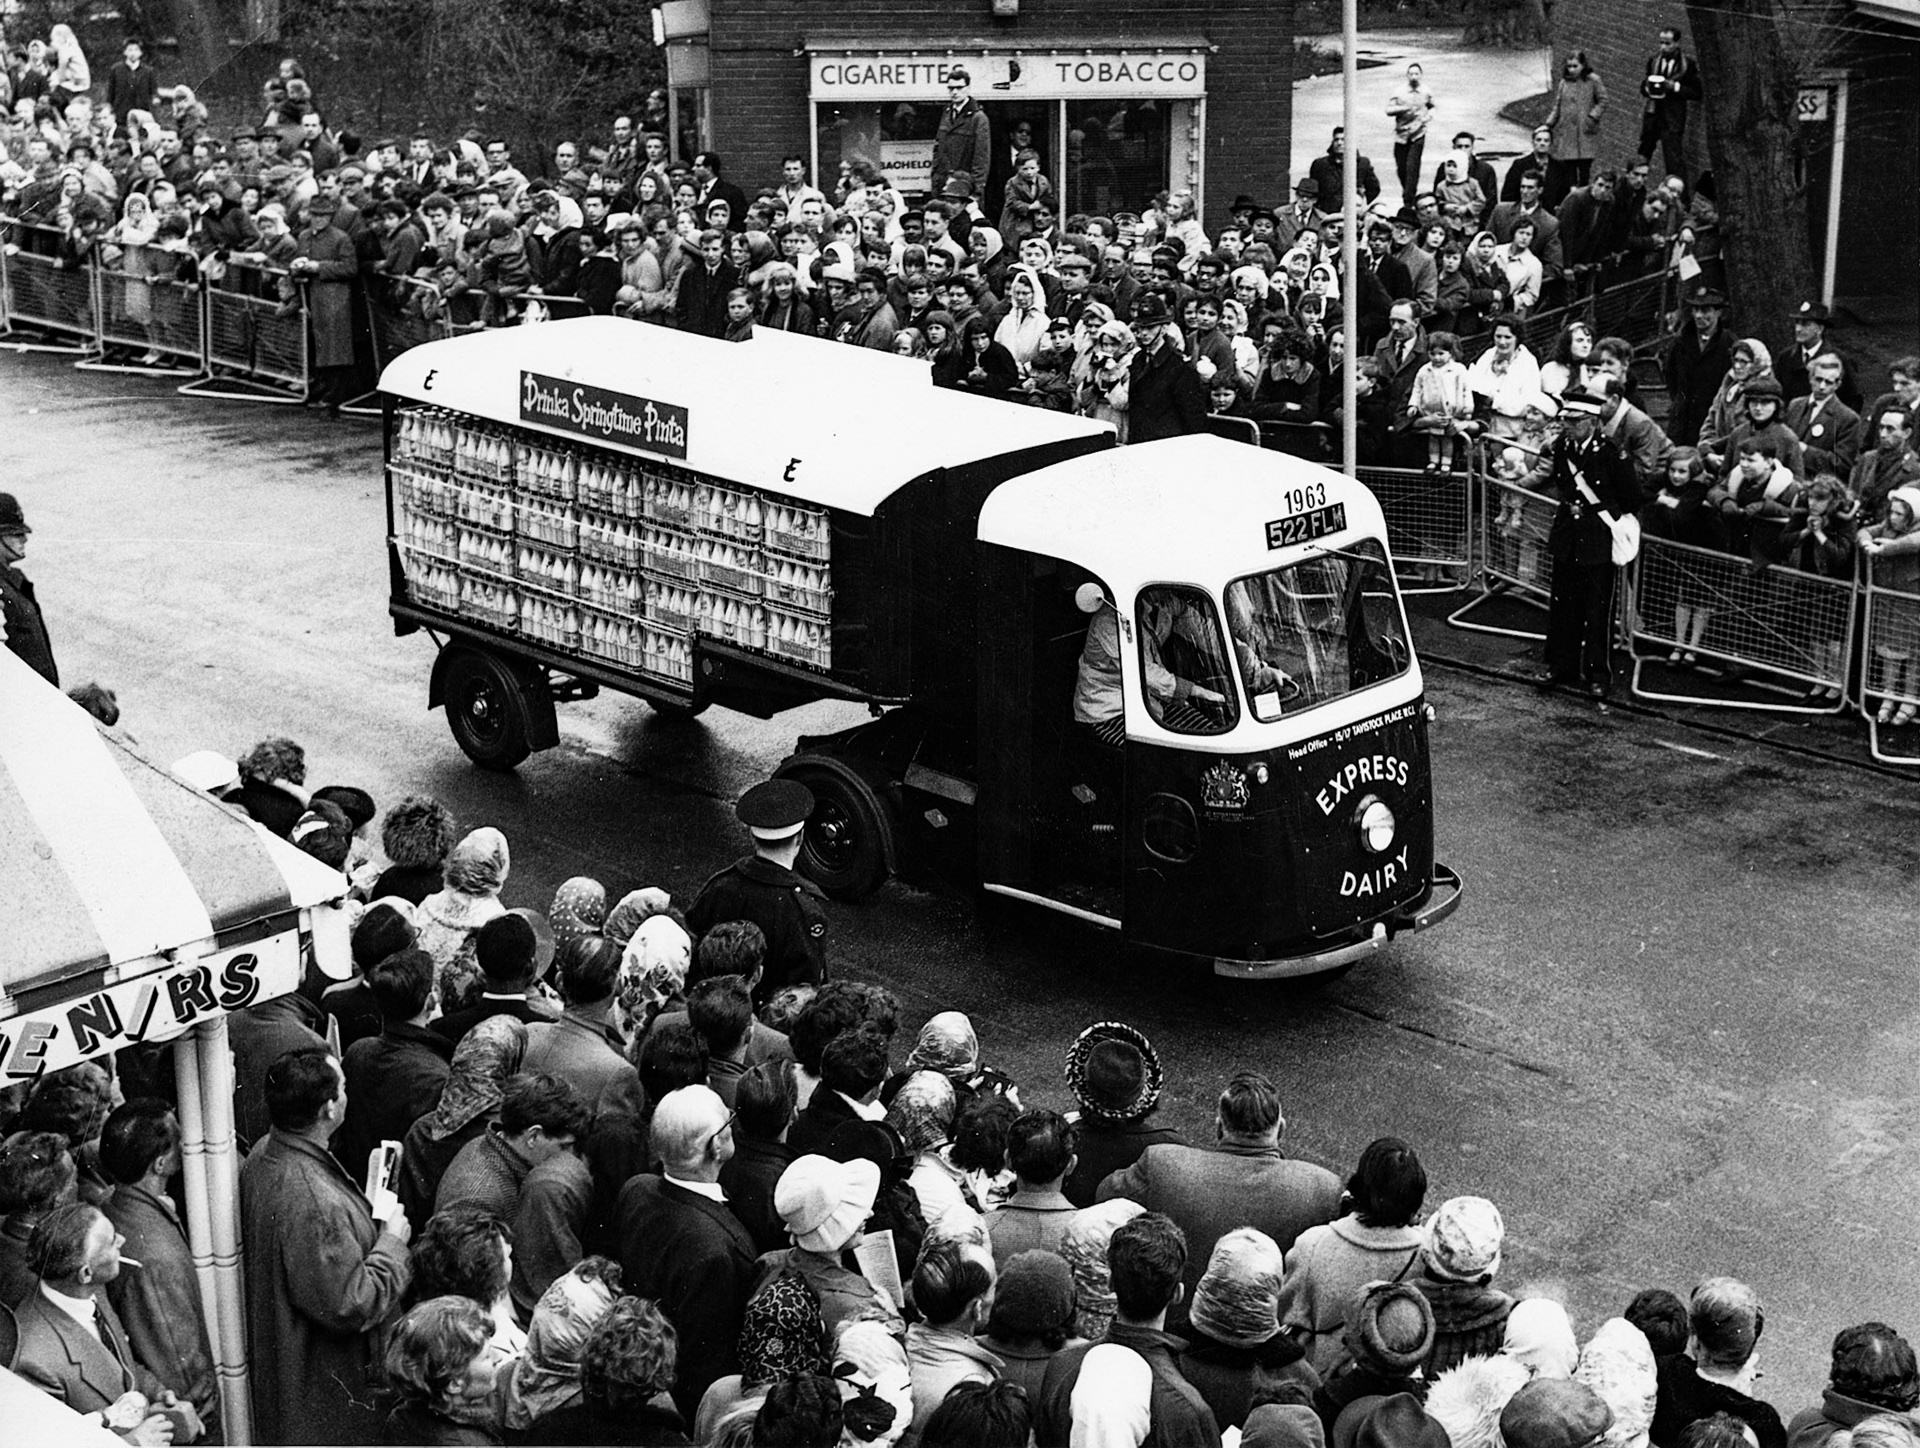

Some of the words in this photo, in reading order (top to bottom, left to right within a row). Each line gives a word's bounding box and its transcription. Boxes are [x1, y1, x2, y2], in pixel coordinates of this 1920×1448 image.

[1056, 61, 1198, 83] TOBACCO
[523, 373, 570, 419] Drinka
[571, 388, 642, 436] Springtime
[644, 401, 685, 447] Pinta
[1284, 482, 1326, 514] 1963
[1269, 516, 1308, 547] 522
[1310, 505, 1344, 537] FLM
[1288, 745, 1308, 760] Head
[1307, 738, 1328, 753] Office
[1351, 716, 1385, 736] TAVISTOCK
[1315, 755, 1409, 816] EXPRESS
[1340, 844, 1408, 897] DAIRY
